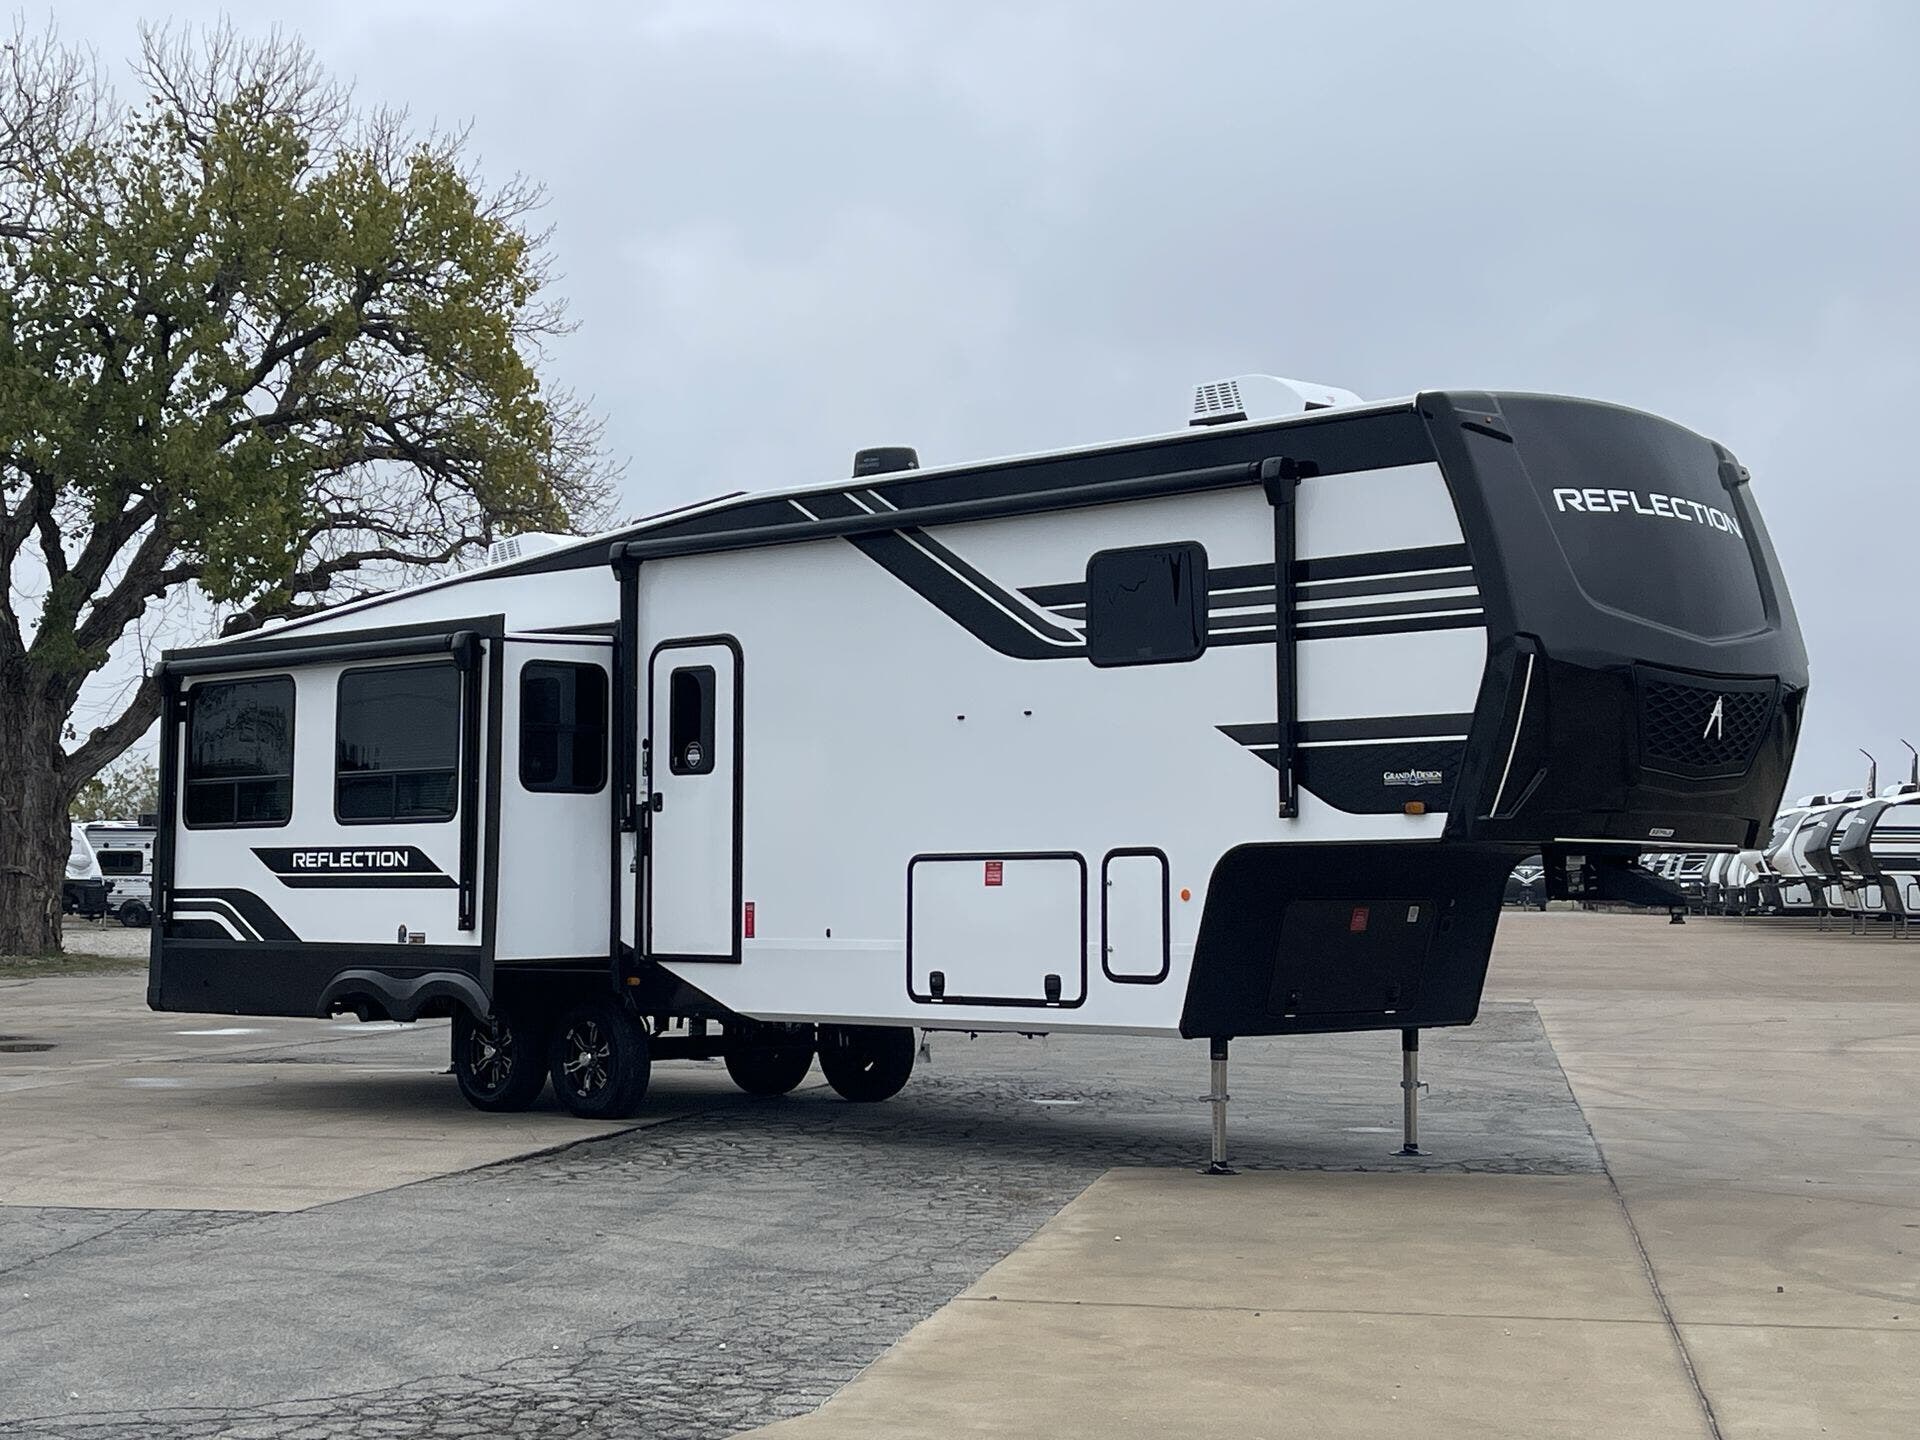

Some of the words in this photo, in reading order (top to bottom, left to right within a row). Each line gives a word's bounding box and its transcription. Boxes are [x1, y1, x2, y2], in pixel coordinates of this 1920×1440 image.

[1553, 488, 1743, 539] REFLECTION
[1383, 772, 1410, 780] GRAND
[292, 851, 409, 868] REFLECTION
